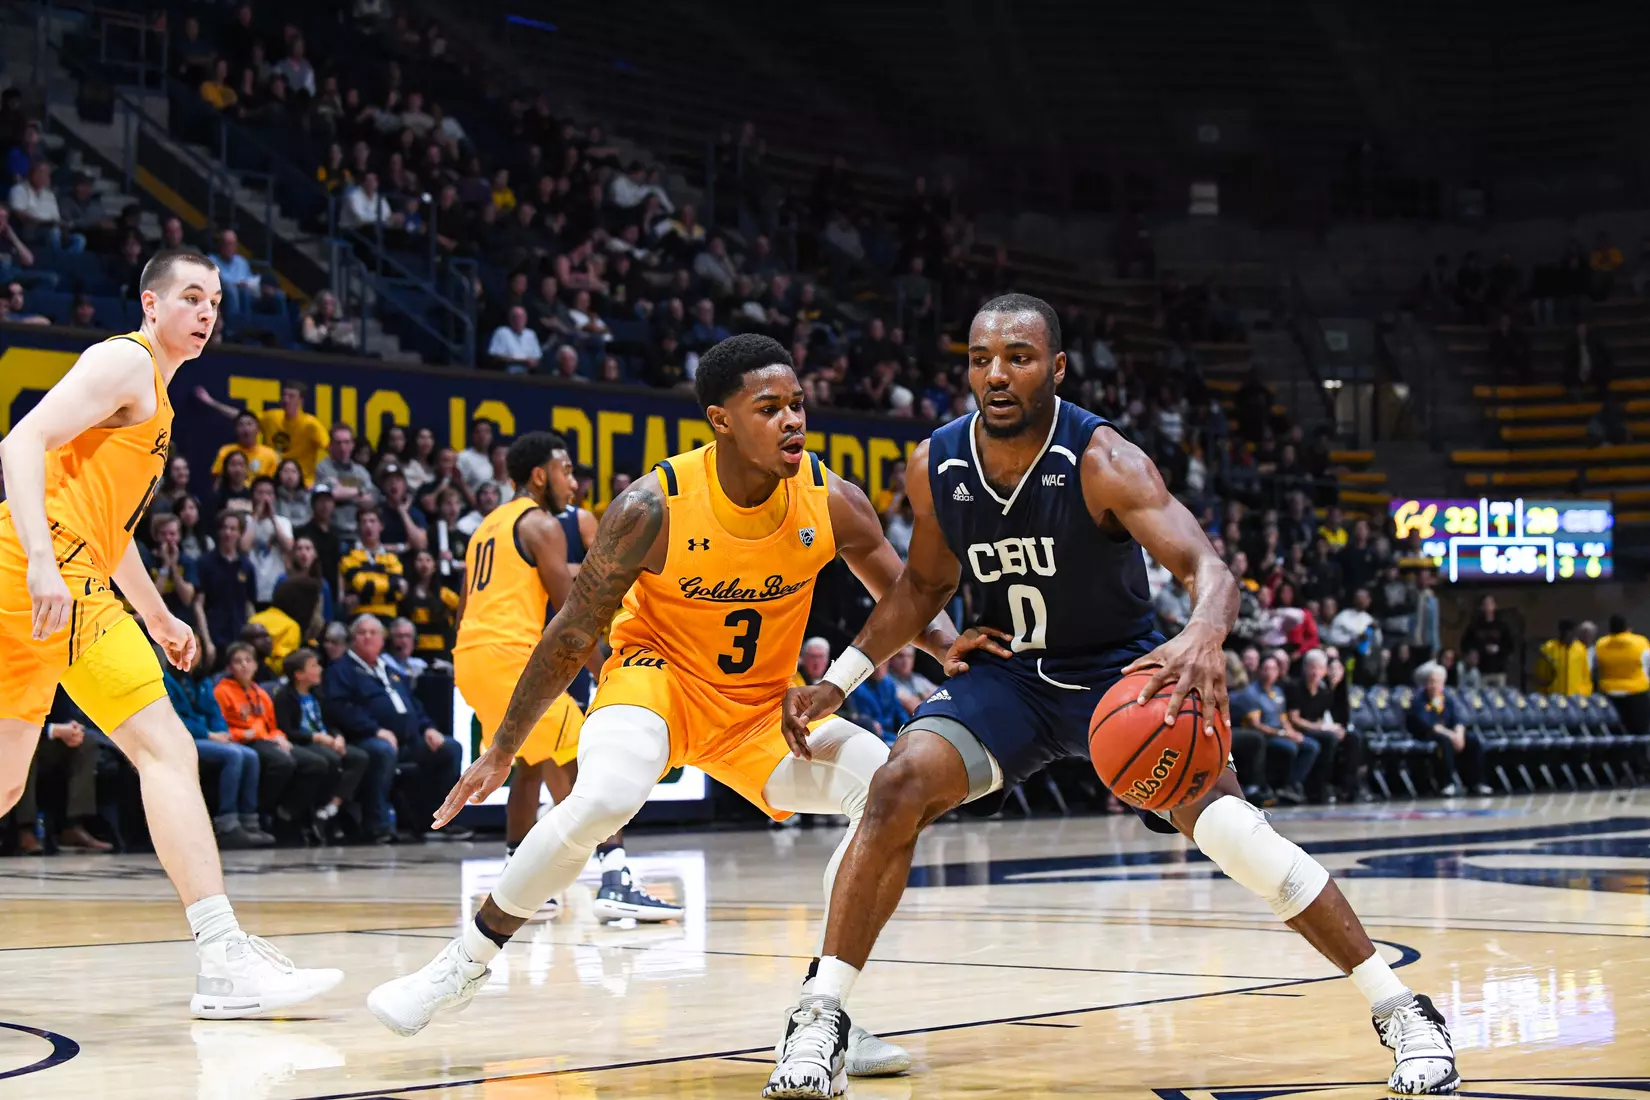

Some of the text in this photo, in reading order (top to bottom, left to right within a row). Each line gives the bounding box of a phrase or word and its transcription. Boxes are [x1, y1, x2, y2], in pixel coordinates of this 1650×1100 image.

[1041, 474, 1066, 487] WAC
[952, 493, 975, 502] adidas
[1444, 506, 1478, 534] 32
[469, 537, 495, 596] 10
[967, 537, 1057, 583] CBU
[1558, 556, 1575, 578] 3
[679, 576, 757, 599] Golden
[1007, 584, 1047, 653] 0
[718, 608, 762, 675] 3
